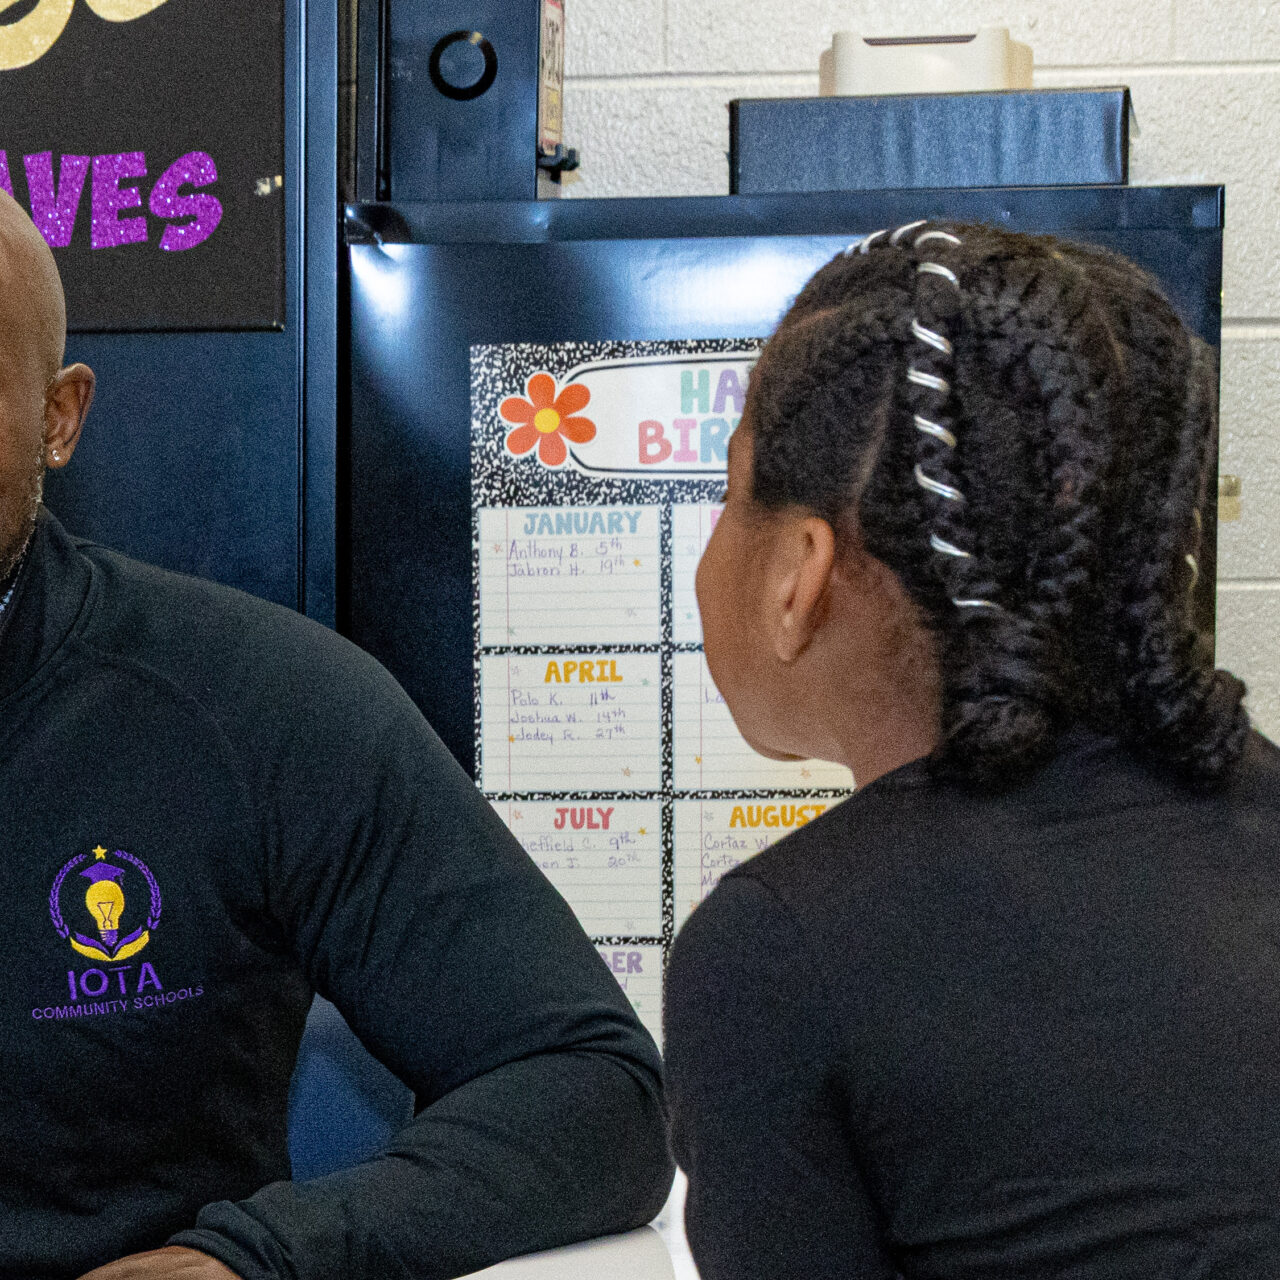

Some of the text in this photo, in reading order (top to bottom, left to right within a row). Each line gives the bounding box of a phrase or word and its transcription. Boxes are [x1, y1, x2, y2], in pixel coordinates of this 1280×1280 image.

[638, 418, 739, 464] BIR
[523, 510, 643, 535] JANUARY
[508, 539, 563, 566] Anthony
[544, 659, 623, 684] APRIL
[510, 711, 561, 724] Joshua
[553, 807, 614, 830] JULY
[520, 834, 574, 852] heffield
[67, 962, 163, 1000] IOTA
[31, 985, 205, 1020] COMMUNITY SCHOOLS
